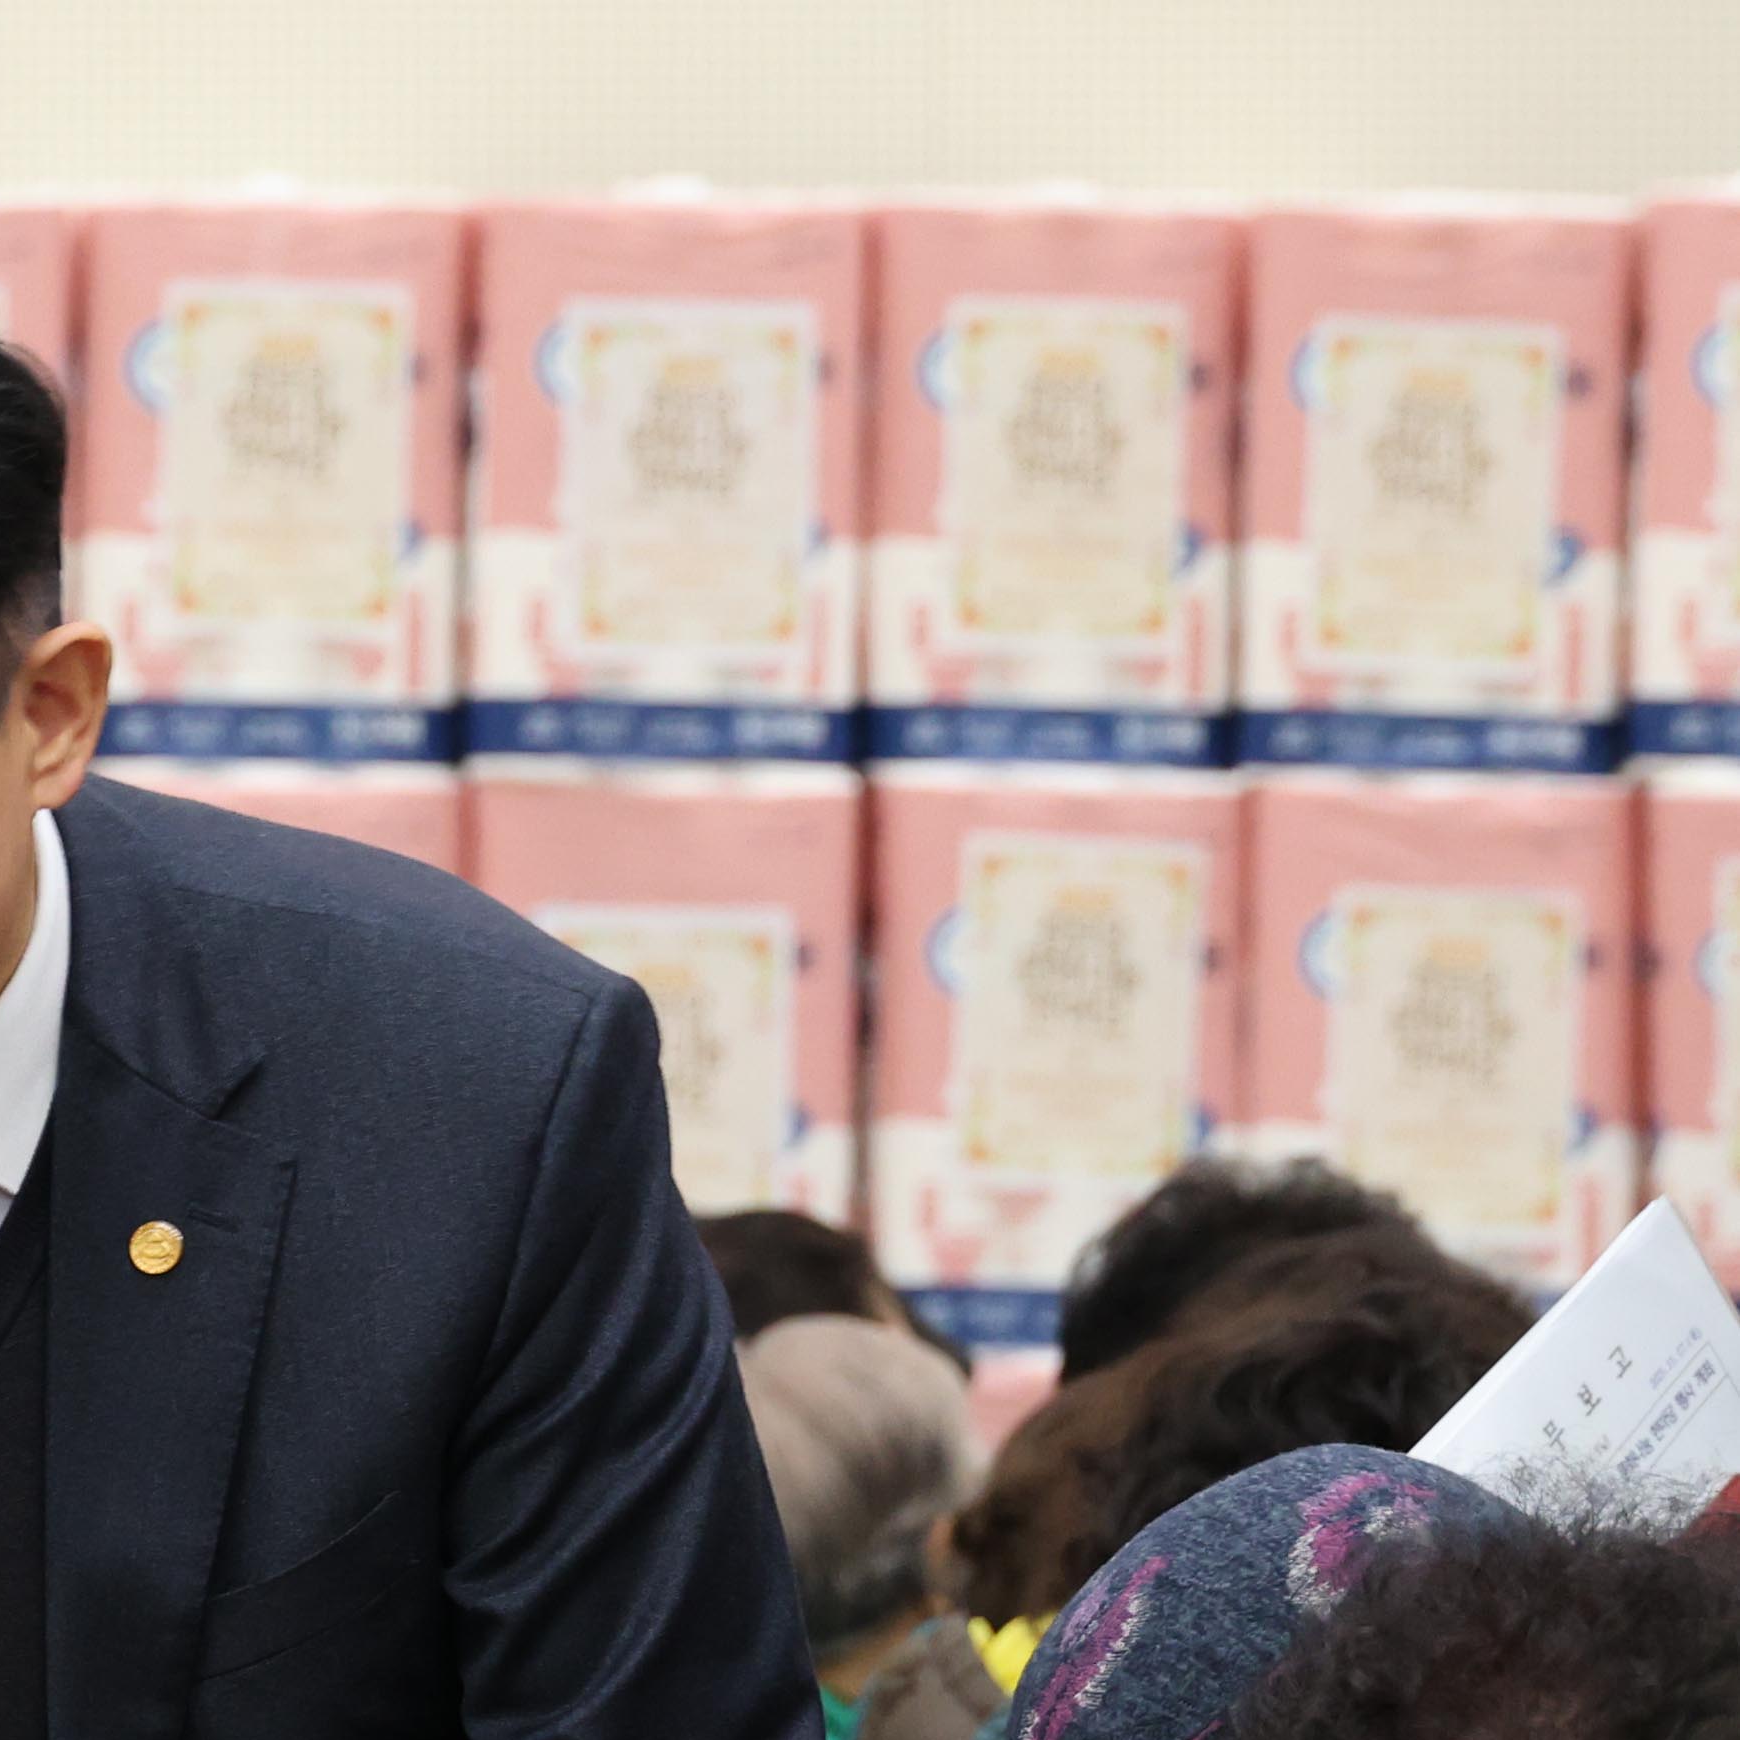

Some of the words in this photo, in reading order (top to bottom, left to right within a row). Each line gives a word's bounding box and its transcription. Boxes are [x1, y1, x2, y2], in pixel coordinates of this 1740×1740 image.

[1542, 1419, 1566, 1452] 무
[1576, 1383, 1602, 1416] 보
[1608, 1345, 1633, 1379] 고
